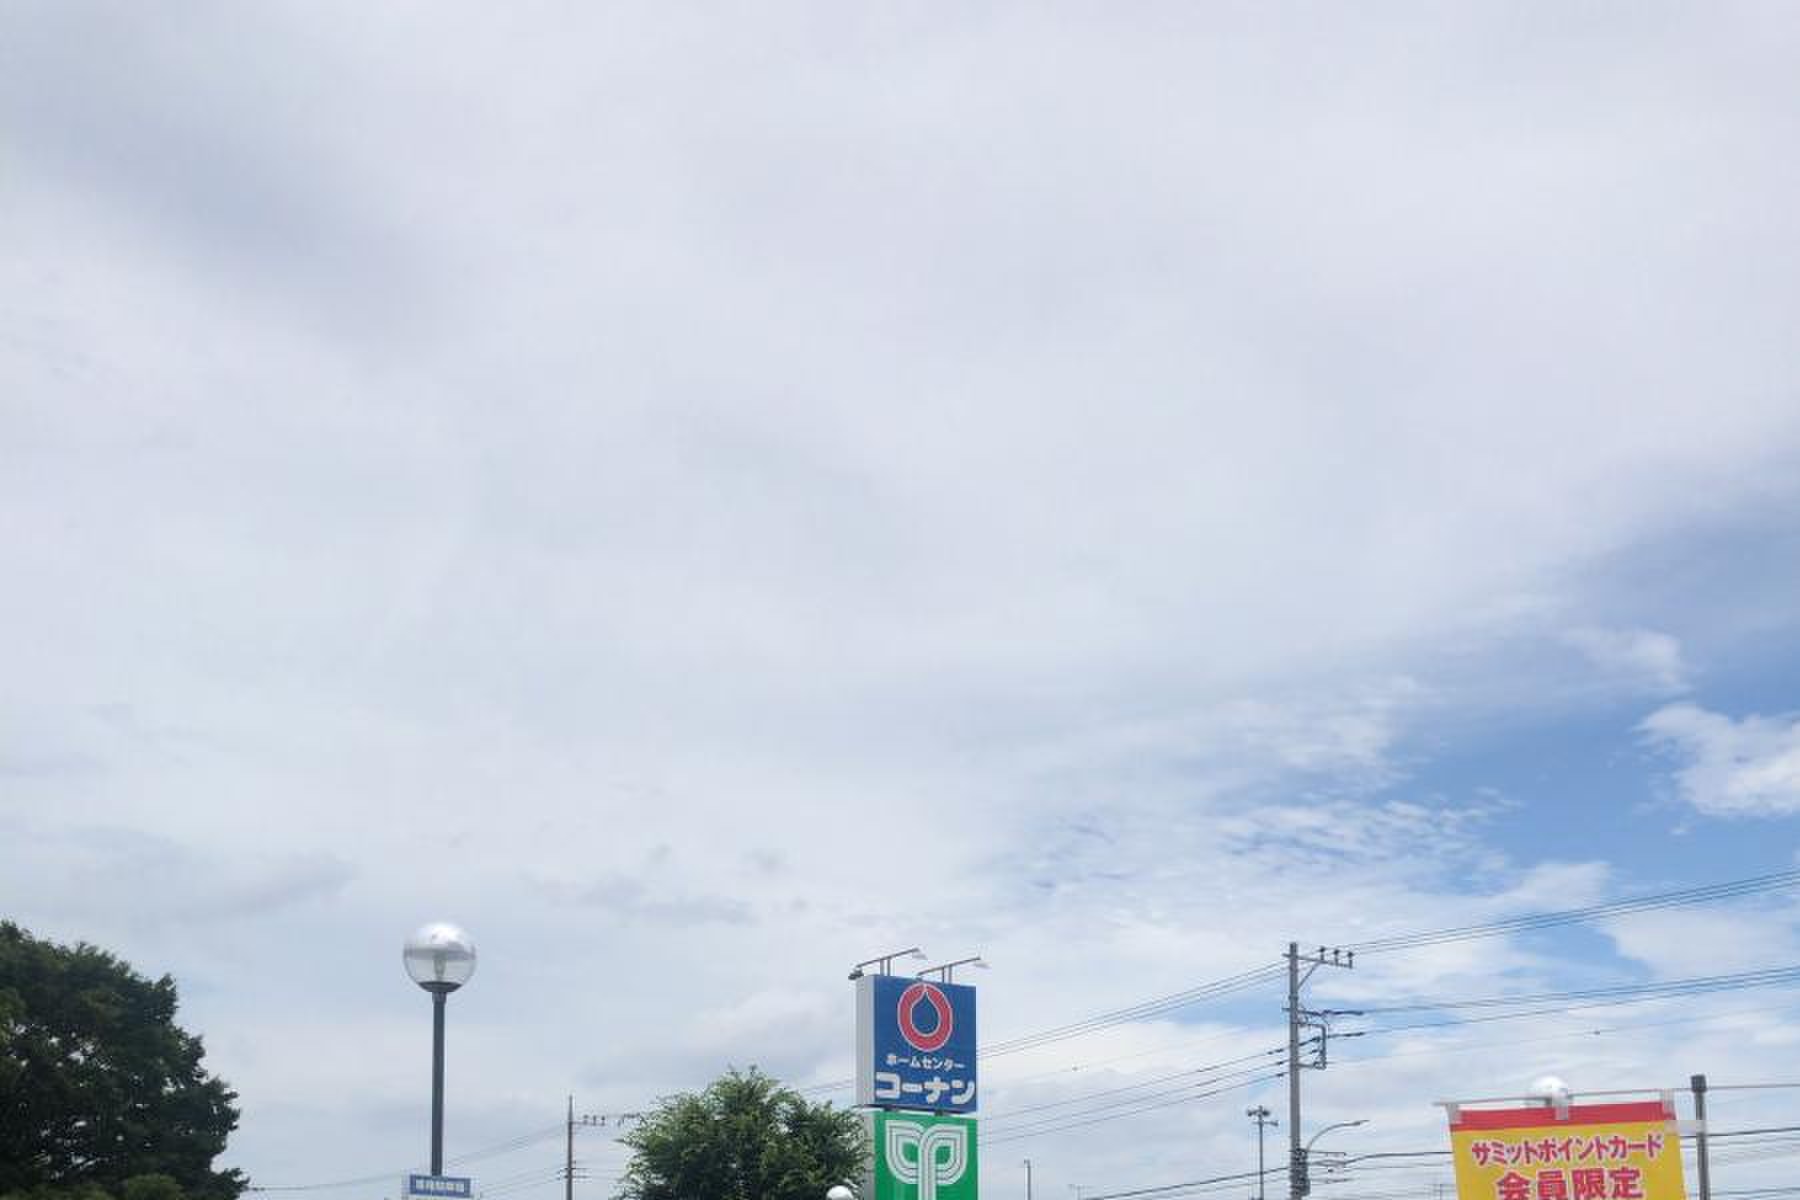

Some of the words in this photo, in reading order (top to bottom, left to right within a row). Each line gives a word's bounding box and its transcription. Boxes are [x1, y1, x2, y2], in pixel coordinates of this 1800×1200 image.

[886, 1053, 966, 1071] ホームセンター
[876, 1071, 976, 1105] コーナン
[1471, 1133, 1663, 1166] サミットポイントカード
